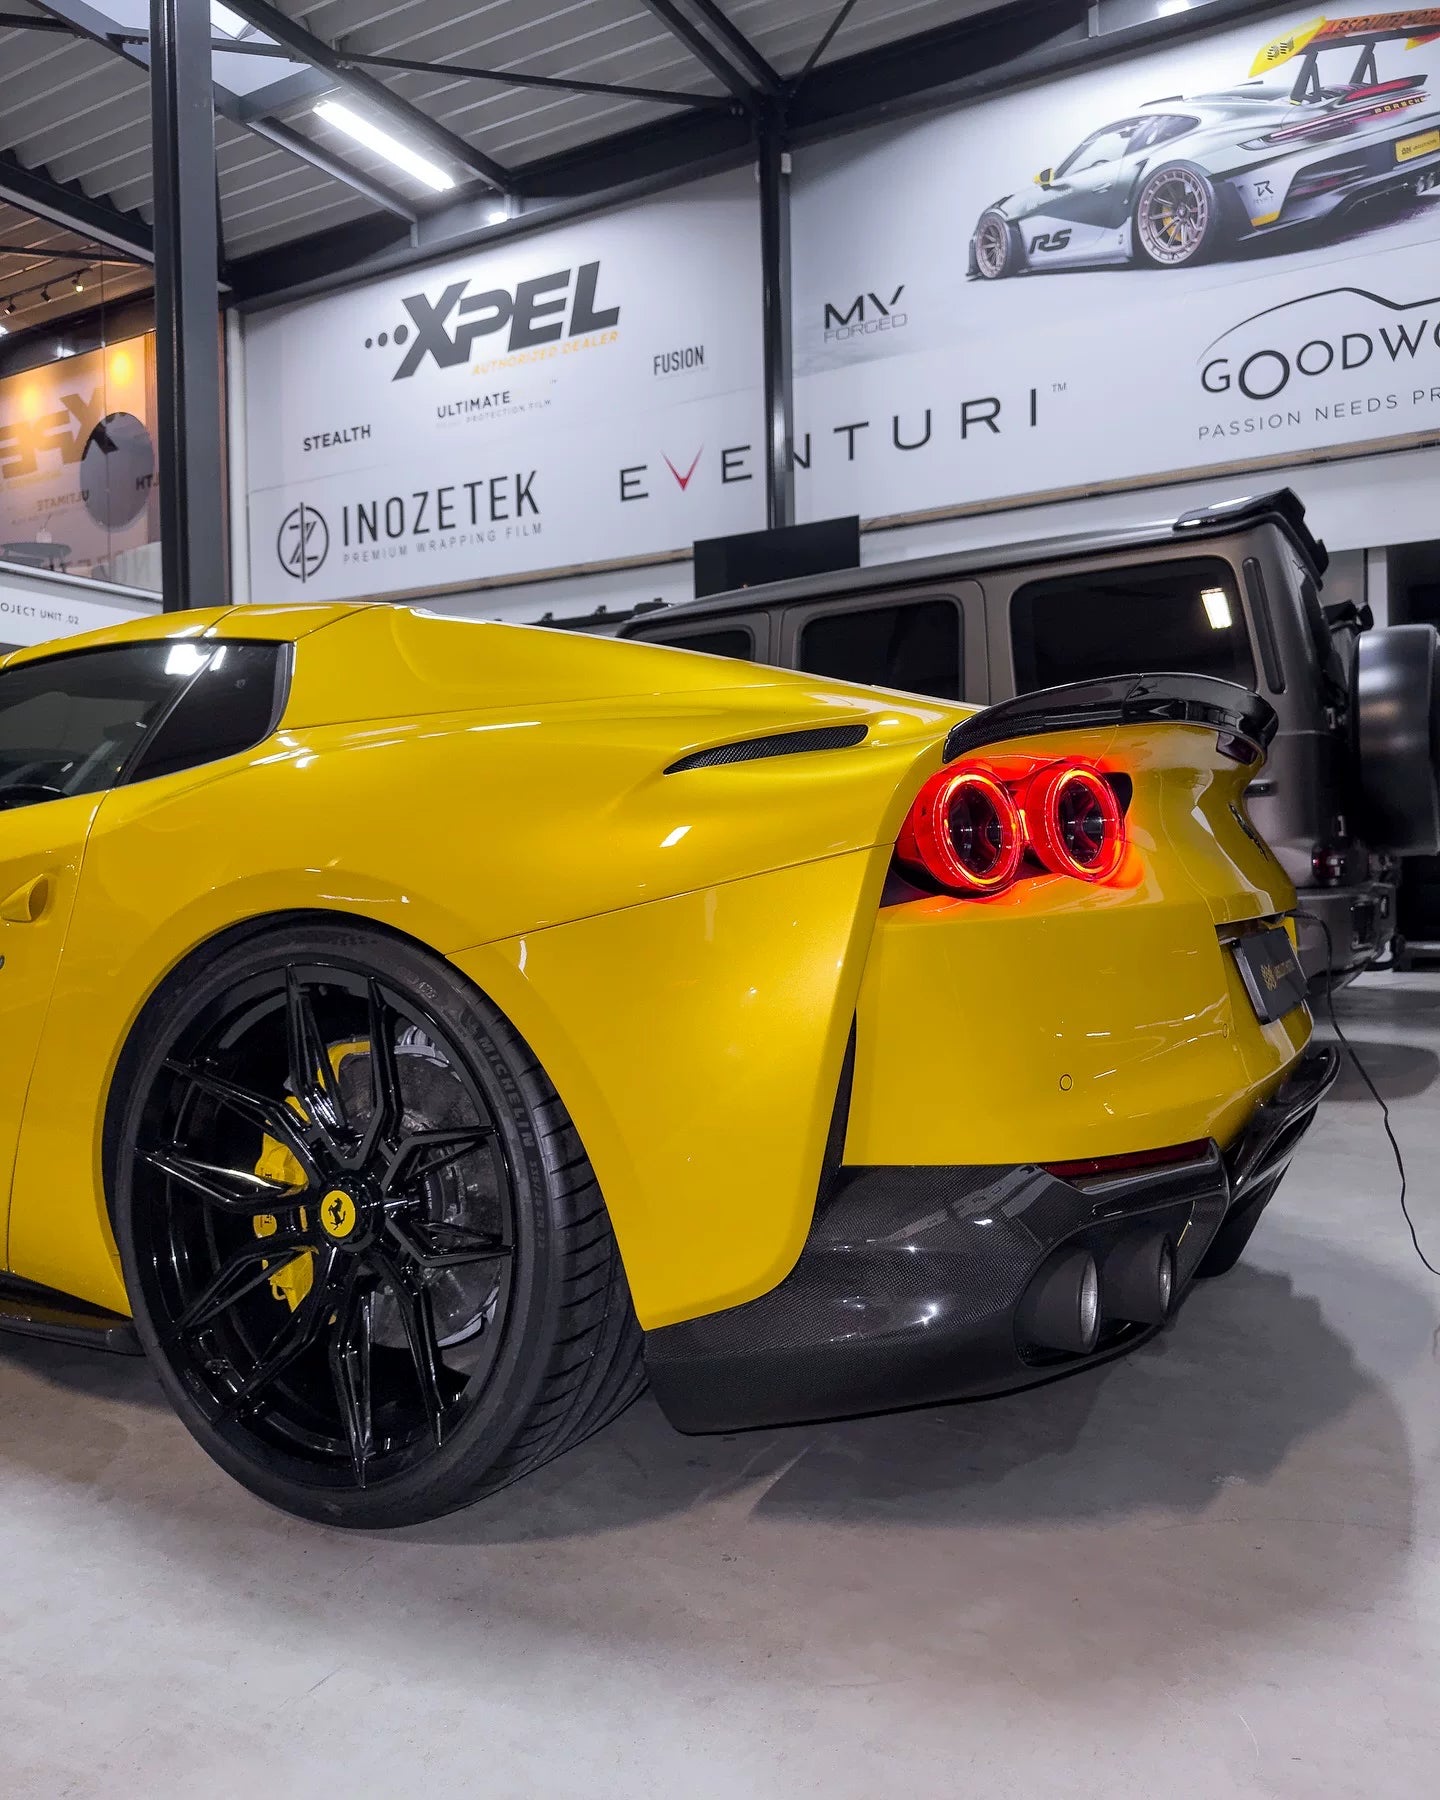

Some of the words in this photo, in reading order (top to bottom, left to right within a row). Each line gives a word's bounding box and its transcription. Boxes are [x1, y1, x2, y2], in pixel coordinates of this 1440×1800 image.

[1374, 97, 1425, 115] PORSCHE
[1029, 228, 1073, 254] RS
[391, 261, 620, 382] XPEL
[824, 285, 905, 329] MV
[824, 313, 908, 343] FORGED
[472, 346, 557, 376] AUTHORIZED
[562, 331, 619, 354] DEALER
[653, 345, 705, 376] FUSION
[1201, 320, 1440, 401] GOODW
[437, 391, 511, 419] ULTIMATE
[1199, 411, 1301, 440] PASSION
[1315, 394, 1398, 421] NEEDS
[303, 424, 371, 451] STEALTH
[343, 470, 540, 547] INOZETEK
[343, 545, 408, 564] PREMIUM
[416, 529, 497, 553] WRAPPING
[505, 523, 543, 538] FILM
[41, 609, 62, 622] UNIT
[477, 1036, 536, 1148] MICHELIN
